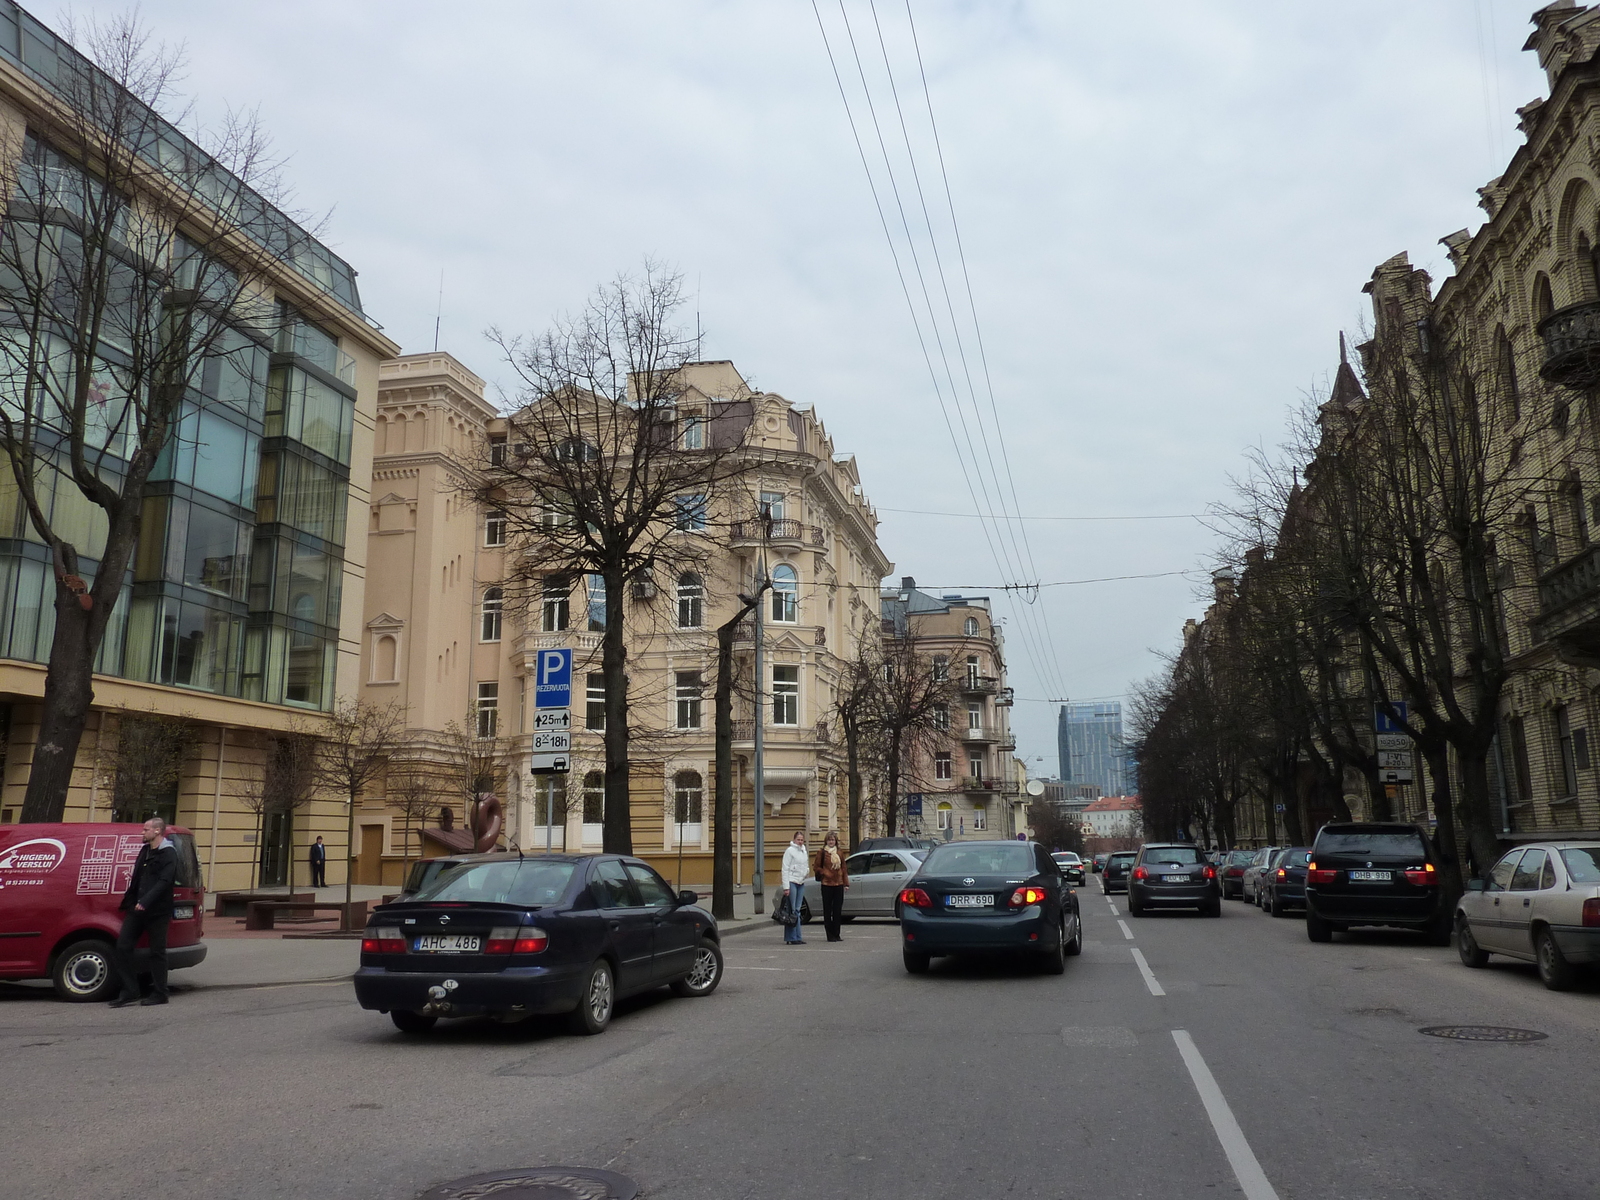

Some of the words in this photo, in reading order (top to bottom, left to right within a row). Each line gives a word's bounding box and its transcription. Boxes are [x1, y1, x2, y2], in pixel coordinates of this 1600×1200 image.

[543, 652, 564, 684] P
[537, 684, 570, 692] REZERVUOTA
[541, 714, 562, 725] 25m
[1375, 872, 1390, 880] 999
[950, 895, 970, 904] DRR
[976, 895, 993, 904] 690
[421, 936, 447, 949] AHC
[455, 936, 478, 949] 486
